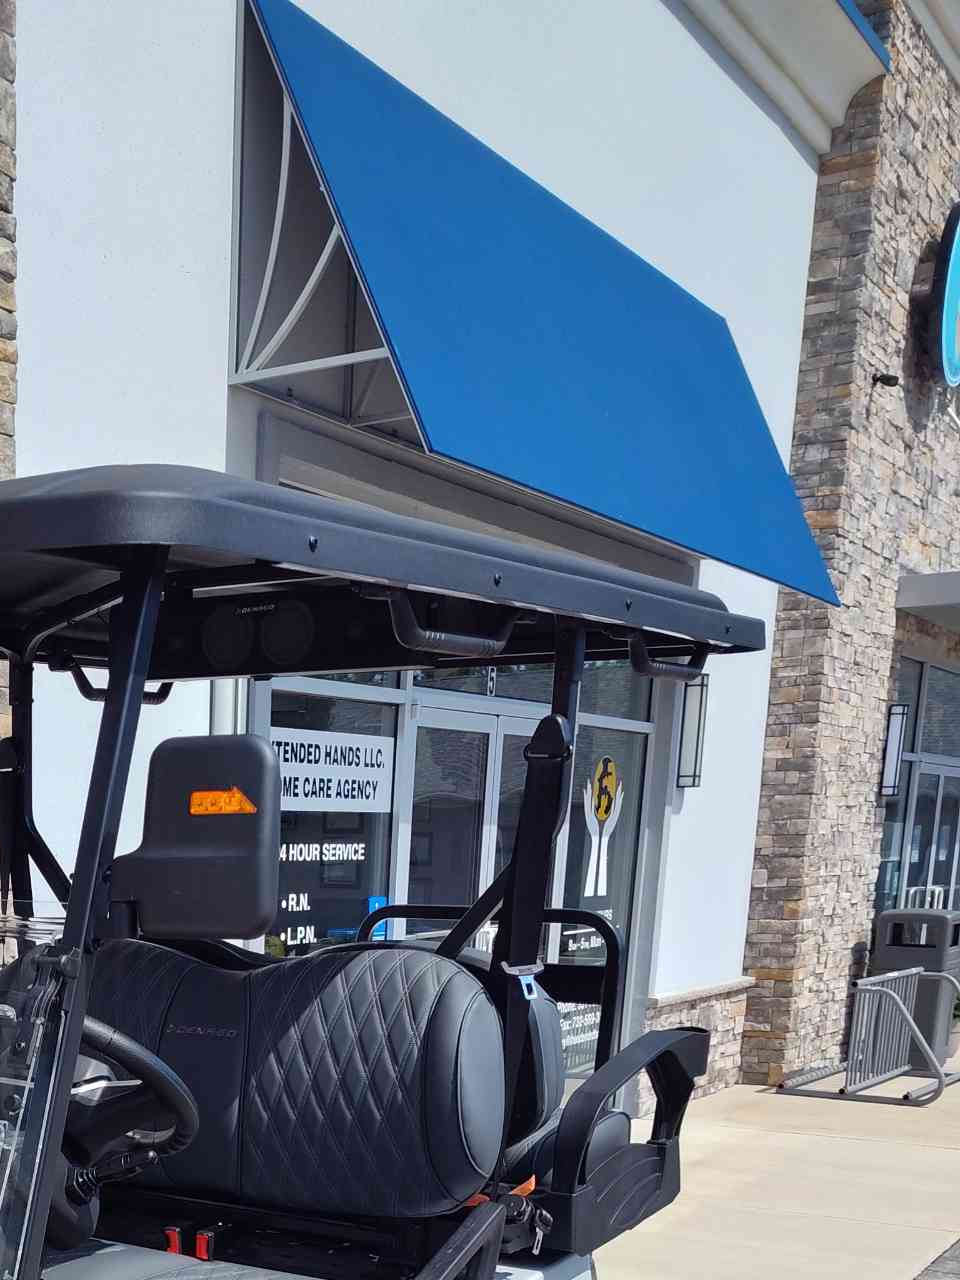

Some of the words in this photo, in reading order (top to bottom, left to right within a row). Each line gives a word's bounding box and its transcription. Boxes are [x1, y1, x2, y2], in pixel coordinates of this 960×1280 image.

[271, 740, 321, 764] TENDED
[324, 745, 361, 767] HANDS
[363, 747, 385, 769] LLC.
[280, 776, 299, 798] ME
[302, 777, 333, 798] CARE
[335, 779, 378, 800] AGENCY
[279, 843, 287, 861] 4
[288, 843, 320, 861] HOUR
[322, 842, 365, 861] SERVICE
